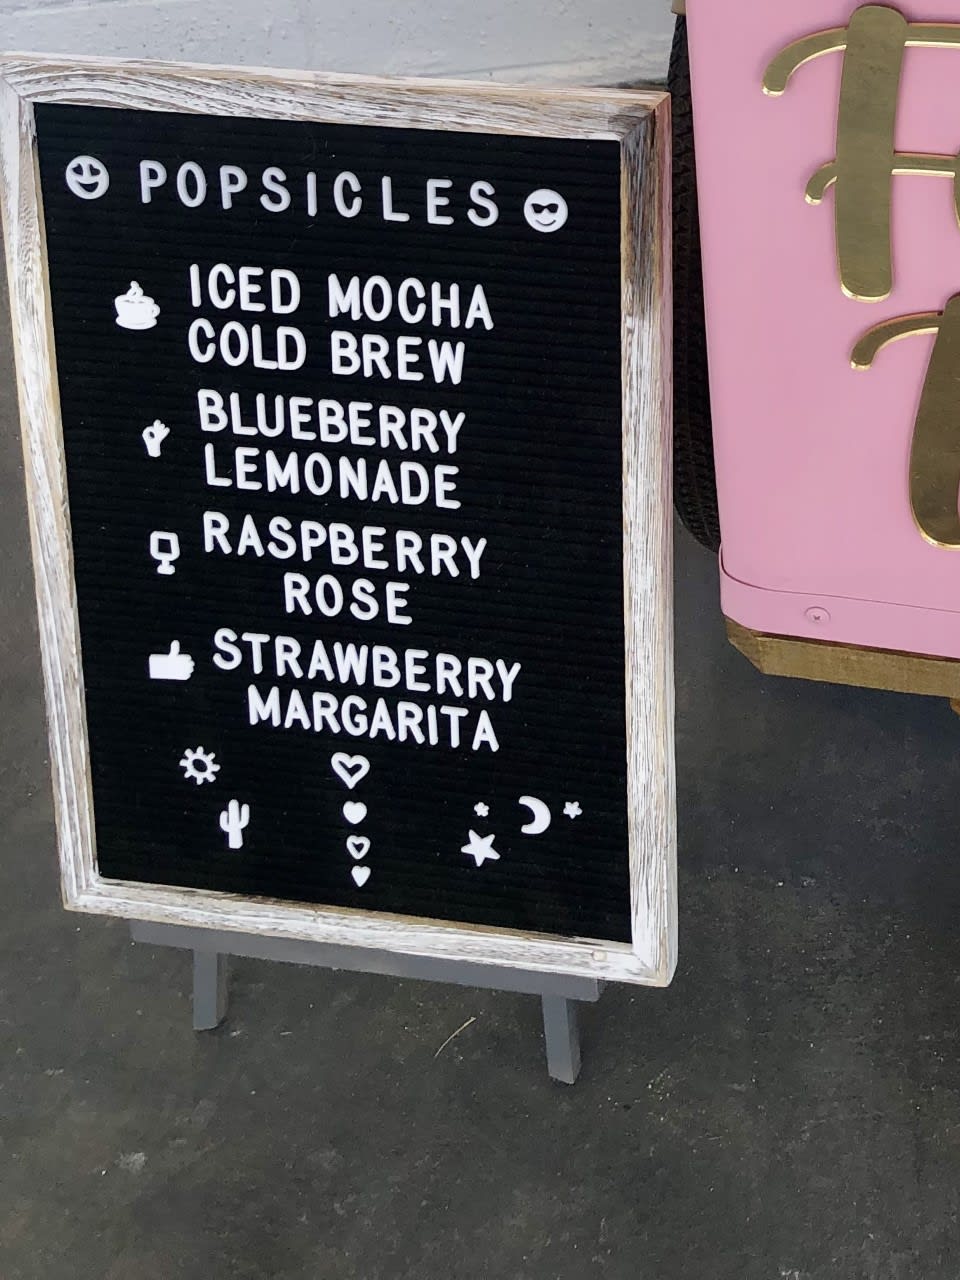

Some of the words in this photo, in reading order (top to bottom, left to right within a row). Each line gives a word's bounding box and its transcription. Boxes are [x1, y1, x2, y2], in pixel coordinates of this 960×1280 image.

[139, 159, 500, 227] POPSICLES
[189, 263, 301, 315] ICED
[327, 273, 494, 331] MOCHA
[188, 317, 307, 371] COLD
[330, 330, 465, 385] BREW
[197, 388, 466, 454] BLUEBERRY
[204, 442, 462, 510] LEMONADE
[203, 510, 487, 580] RASPBERRY
[283, 572, 413, 625] ROSE
[212, 627, 522, 703] STRAWBERRY
[247, 684, 500, 753] MARGARITA
